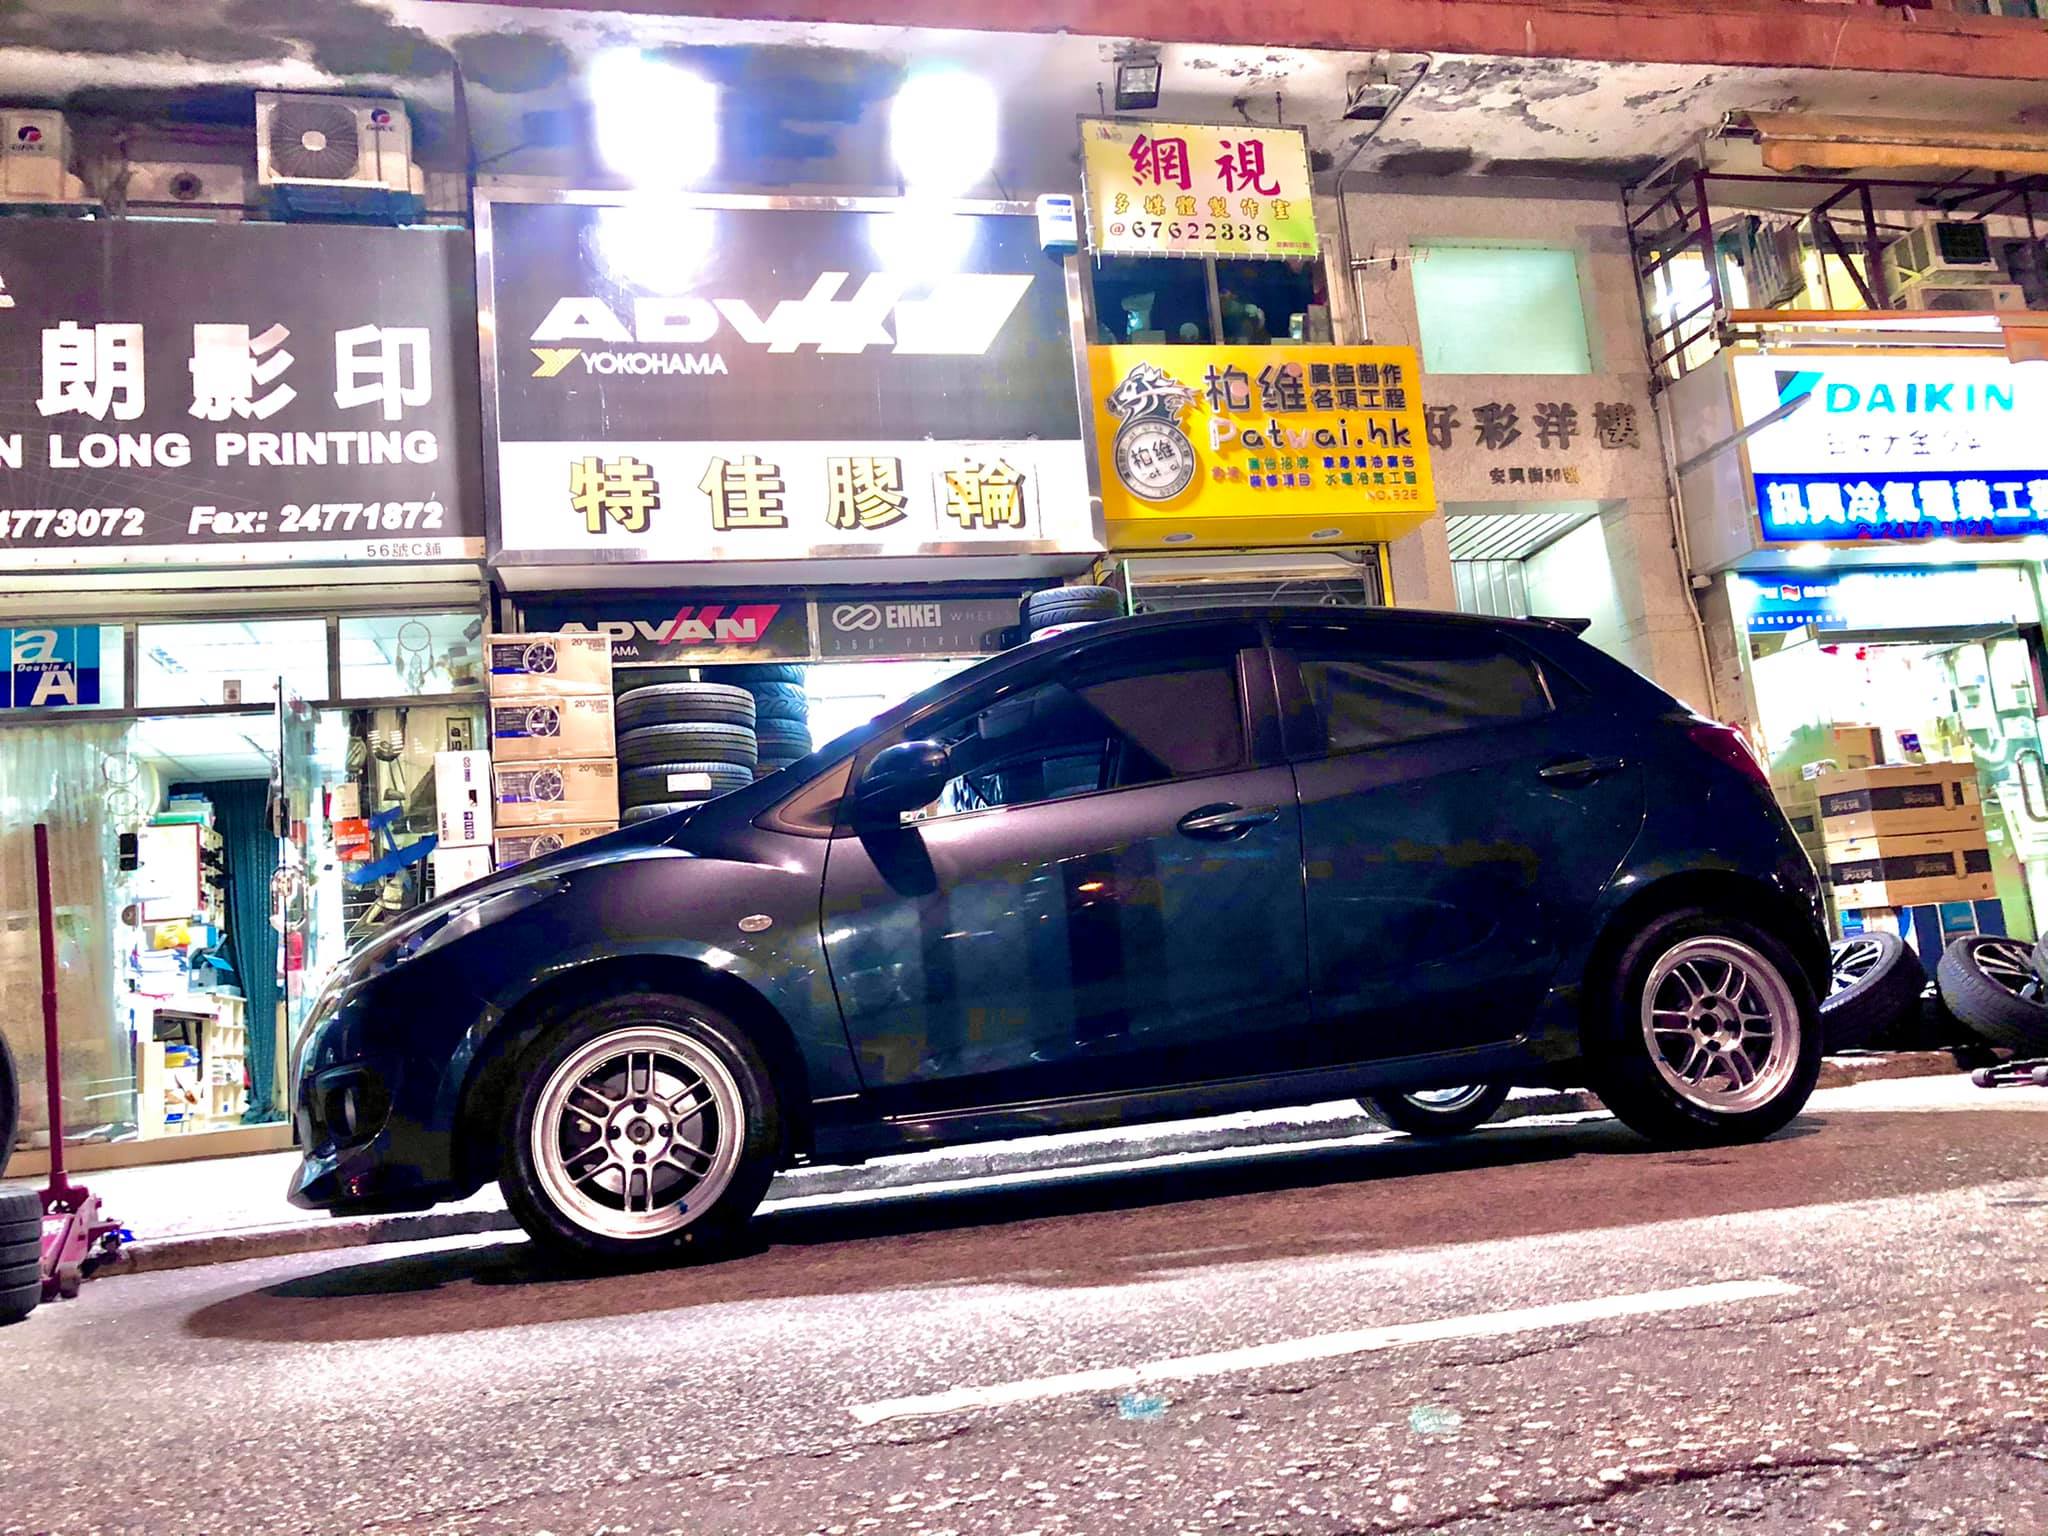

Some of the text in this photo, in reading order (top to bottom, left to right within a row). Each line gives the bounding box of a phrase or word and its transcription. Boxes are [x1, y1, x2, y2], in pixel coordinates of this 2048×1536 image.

[1128, 134, 1281, 196] 網視
[1114, 192, 1290, 219] 多媒體製作室
[529, 273, 1034, 354] ADV
[36, 321, 433, 422] 朗影印
[582, 352, 728, 376] YOKOHAMA
[1310, 364, 1402, 386] 廣告制作
[1312, 388, 1406, 411] 各項工程
[1826, 384, 2014, 413] DAIKIN
[49, 433, 192, 468] LONG
[215, 430, 439, 466] PRINTING
[1208, 417, 1412, 450] Patwai.hk
[569, 456, 1025, 534] 特佳膠輪
[188, 505, 268, 536] Fax:
[279, 501, 444, 533] 24771872
[886, 604, 941, 629] ENKEI
[17, 663, 72, 672] Double A
